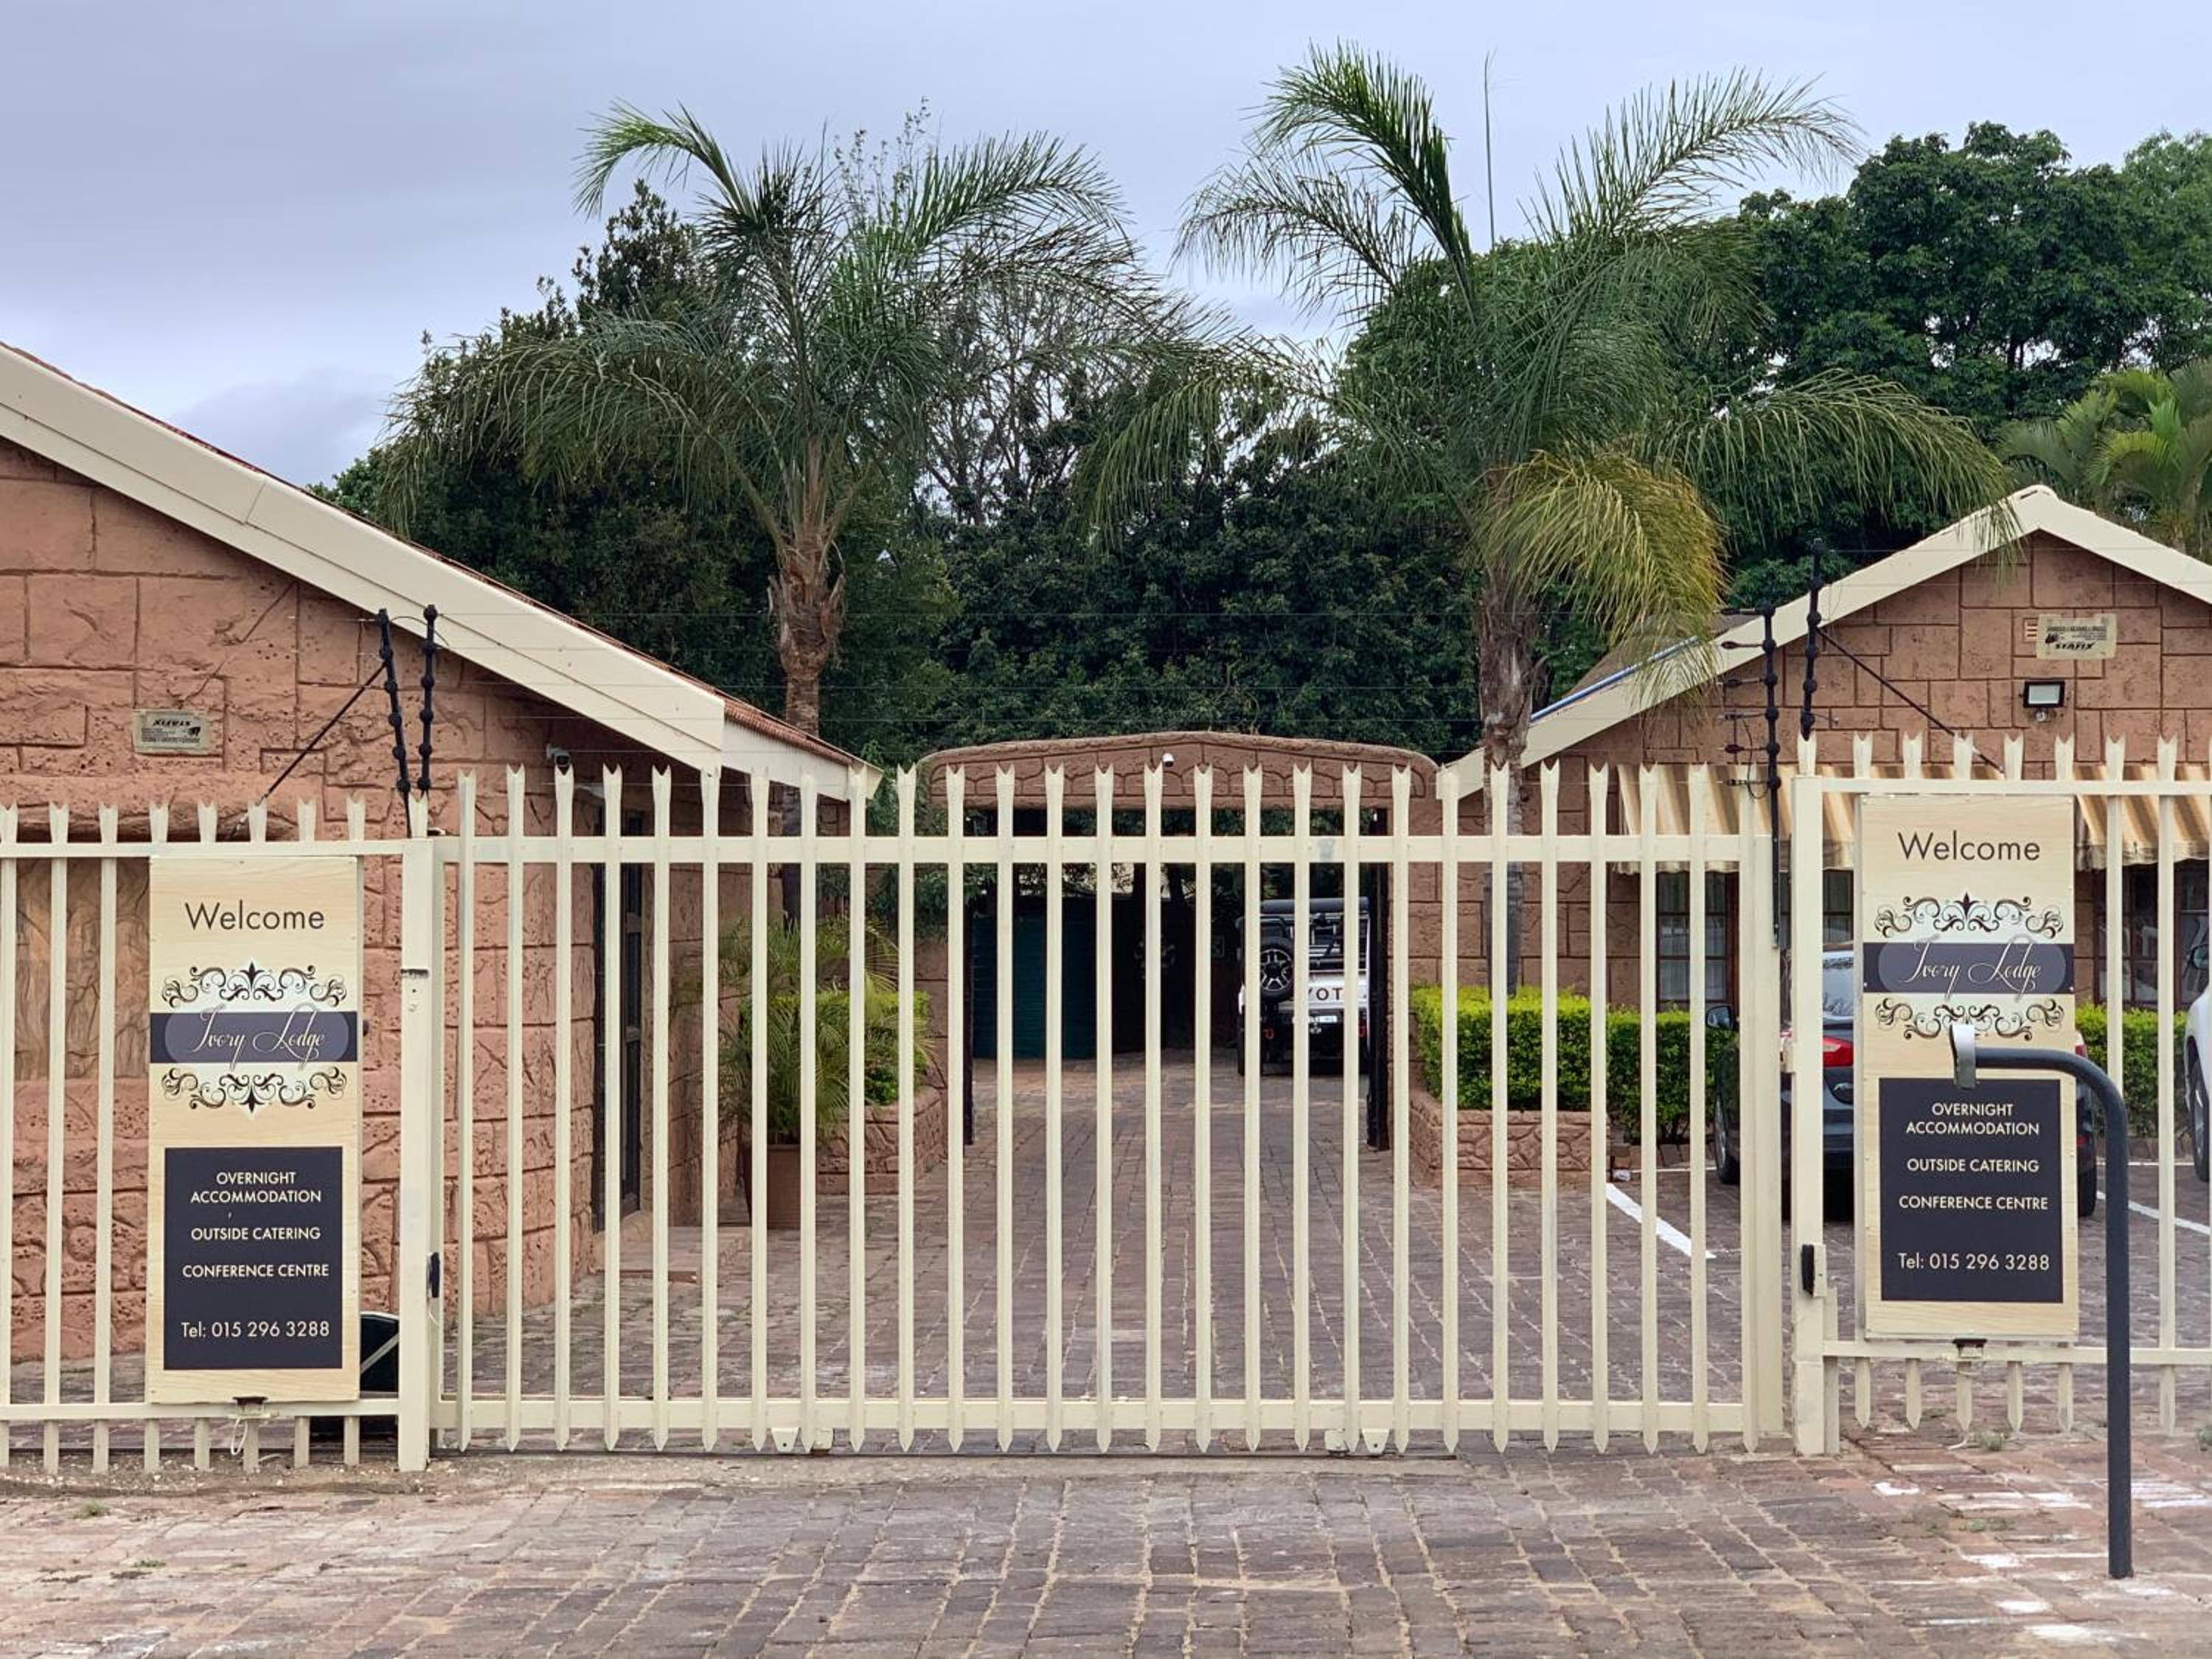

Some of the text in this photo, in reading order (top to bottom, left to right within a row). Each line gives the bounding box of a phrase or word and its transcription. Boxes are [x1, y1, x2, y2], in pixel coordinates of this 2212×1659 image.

[1897, 830, 2041, 861] Welcome
[184, 900, 325, 931] Welcome
[1899, 933, 2042, 1003] Ivory Lodge
[188, 1002, 325, 1071] Ivory Lodge
[1931, 1102, 2013, 1117] OVERNIGHT
[1905, 1121, 2039, 1135] ACCOMMODATION
[1907, 1158, 2039, 1173] OUTSIDE CATERING
[216, 1171, 296, 1185] OVERNIGHT
[190, 1190, 322, 1204] ACCOMMODATION
[1899, 1195, 2048, 1211] CONFERENCE CENTRE
[190, 1226, 321, 1241] OUTSIDE CATERING
[1897, 1253, 2050, 1271] Tel: 015 296 3288
[182, 1264, 330, 1279] CONFERENCE CENTRE
[181, 1321, 330, 1338] Tel: 015 296 3288
